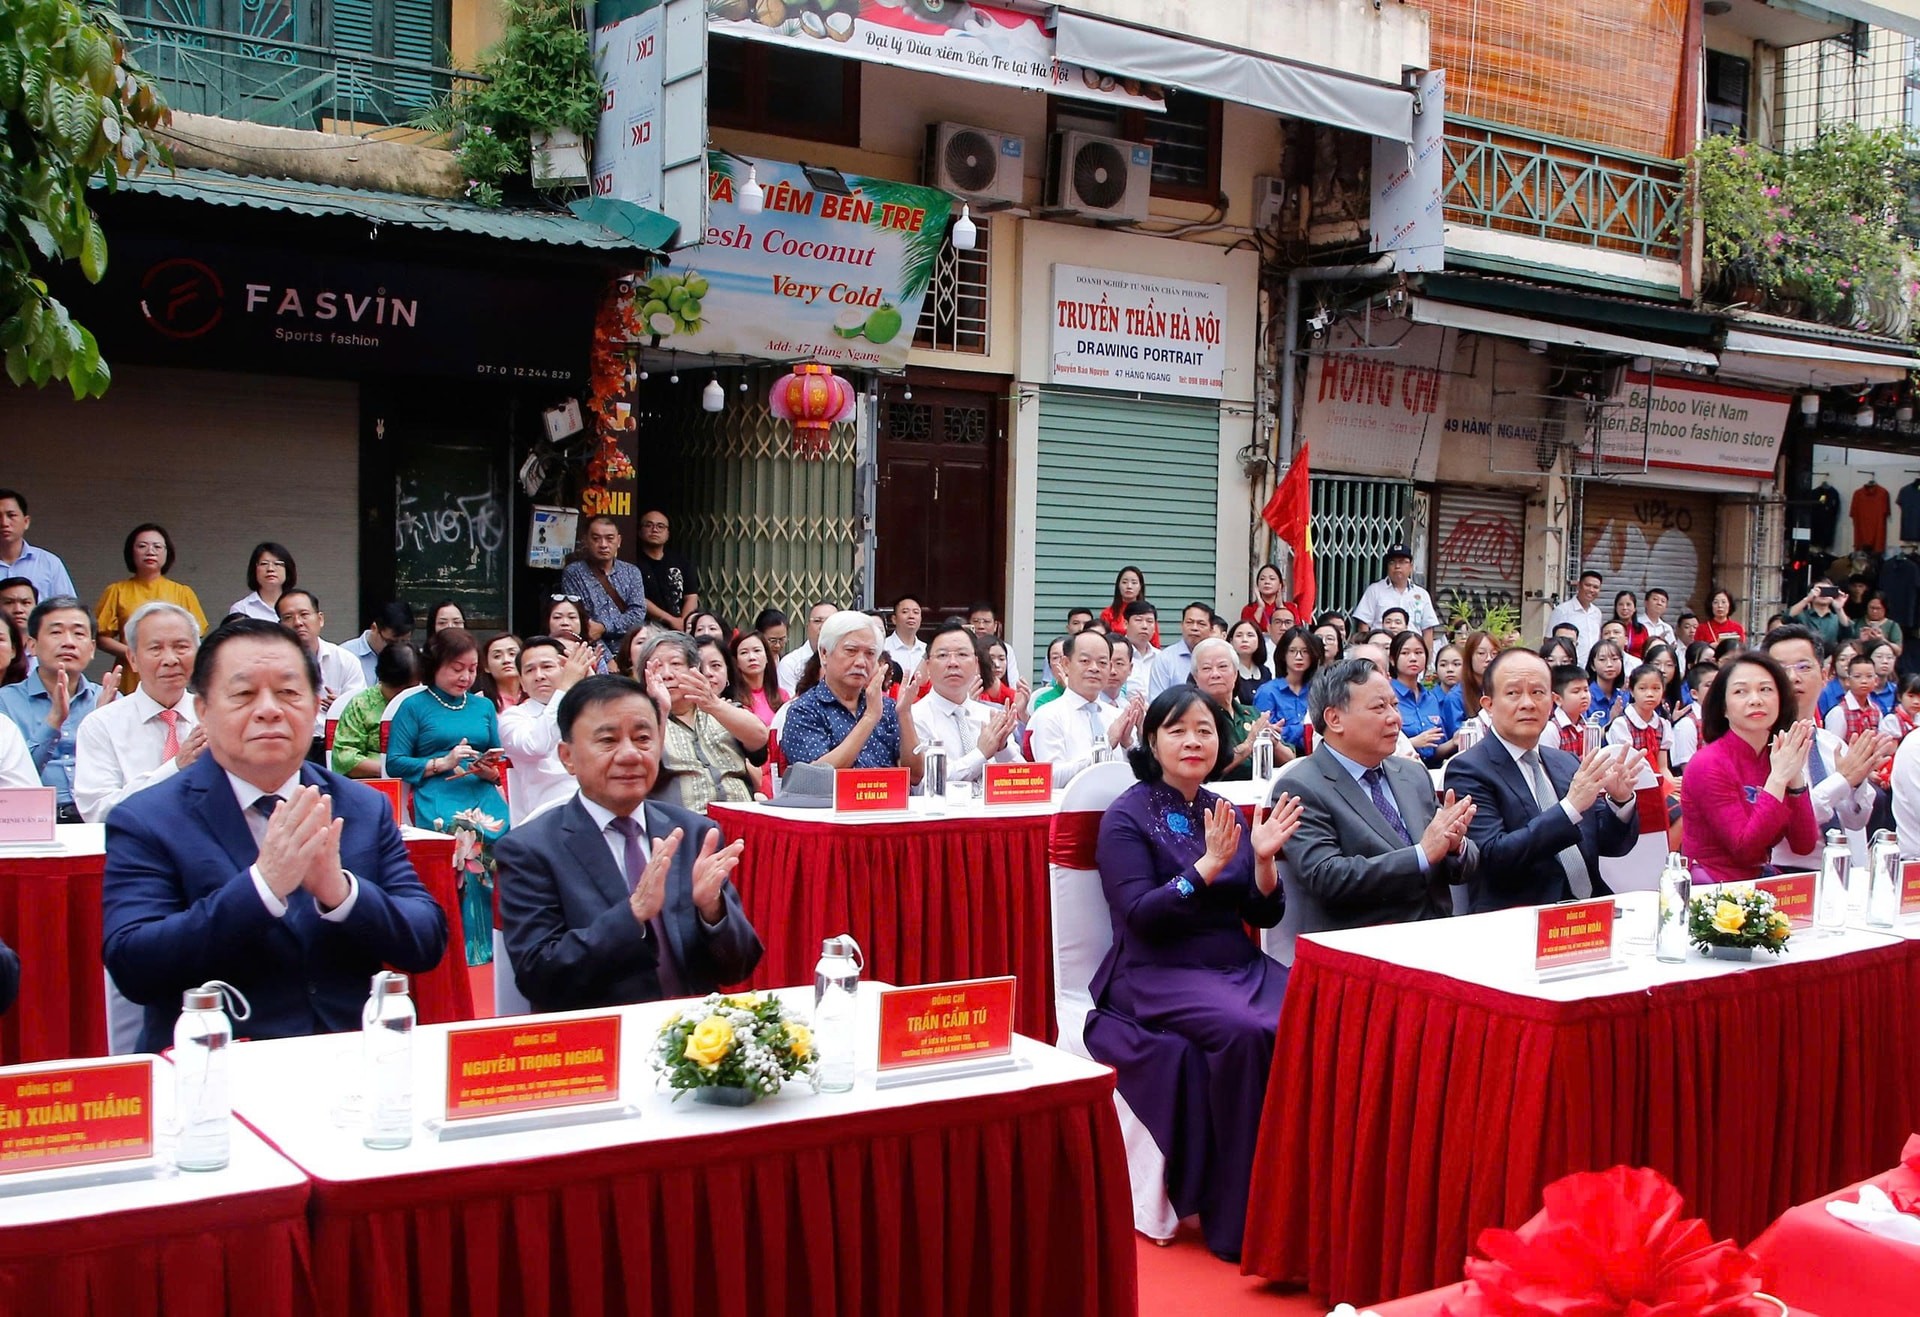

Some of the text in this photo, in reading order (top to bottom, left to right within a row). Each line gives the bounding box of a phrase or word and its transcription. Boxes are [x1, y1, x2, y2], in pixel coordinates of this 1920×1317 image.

[865, 31, 1069, 84] Đại lý Dừa xiêm Bến Tre tại Hà Nội
[758, 180, 814, 215] IÊM
[881, 203, 925, 232] TRE
[762, 229, 877, 267] Coconut
[772, 274, 883, 308] Very Cold
[1076, 276, 1101, 286] DOANH
[1057, 292, 1221, 350] TRUYỀN THẦN HÀ NỘI
[275, 327, 379, 347] Sports fashion
[765, 340, 880, 363] Add: 47 Hàng Ngang
[1077, 340, 1203, 366] DRAWING PORTRAIT
[551, 370, 571, 380] 829
[1115, 368, 1171, 382] 47 HÀNG NGANG
[1628, 391, 1748, 422] Bamboo Việt Nam
[1444, 419, 1459, 432] 49
[1497, 423, 1537, 441] NGANG
[1690, 424, 1739, 445] fashion
[1742, 431, 1775, 448] store
[877, 791, 888, 800] LAN
[931, 991, 965, 1006] ĐỒNG CHÍ
[907, 1006, 987, 1032] TRẦN CẨM TÚ
[462, 1046, 604, 1077] NGUYỄN TRỌNG NGHĨA
[26, 1101, 78, 1127] XUÂN
[82, 1092, 142, 1120] THẮNG
